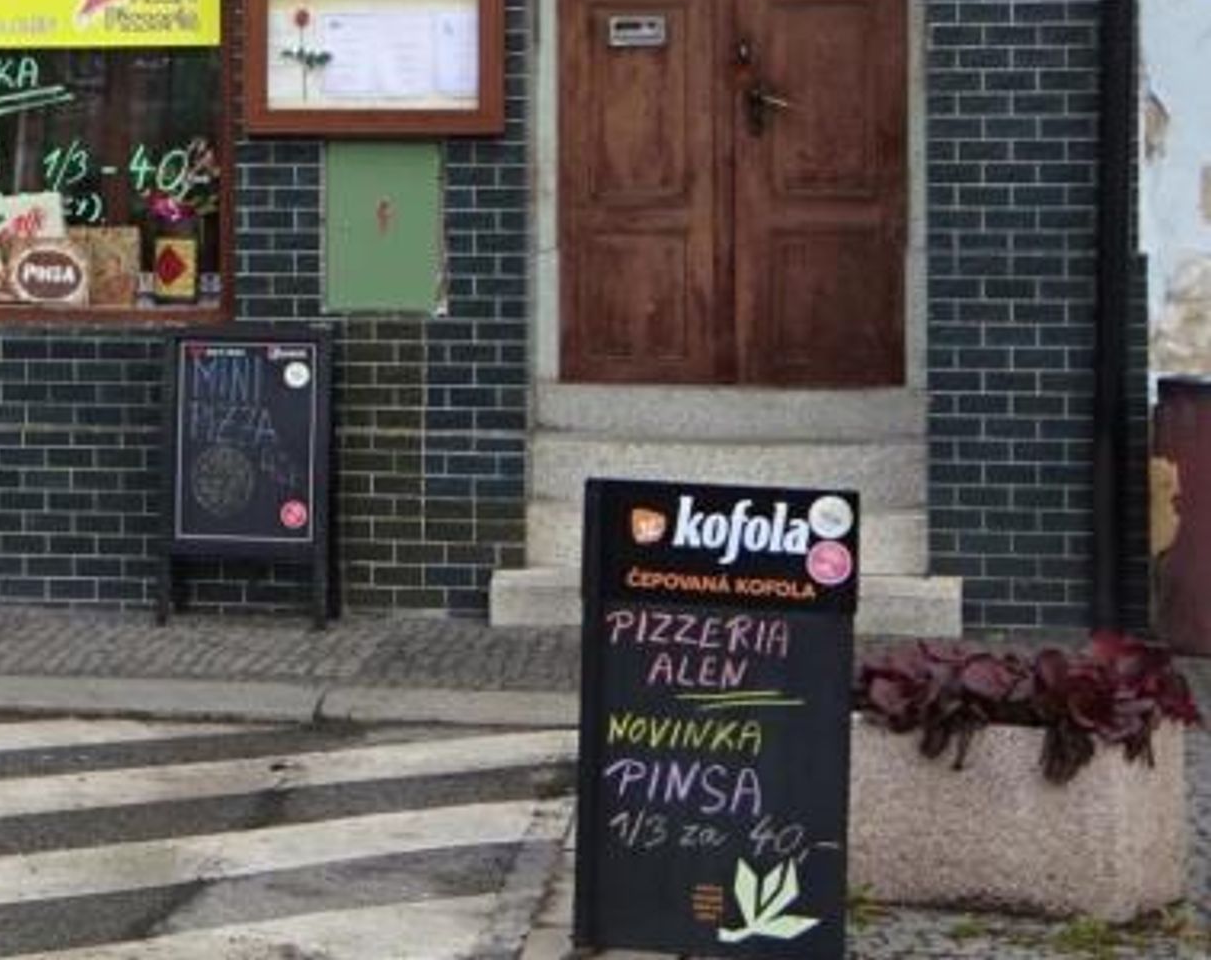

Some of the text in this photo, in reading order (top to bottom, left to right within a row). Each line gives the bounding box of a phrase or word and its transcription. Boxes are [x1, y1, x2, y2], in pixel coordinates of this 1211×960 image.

[43, 141, 89, 191] 1/3
[22, 261, 76, 283] PINSA
[672, 496, 810, 564] kofola
[627, 567, 817, 599] ČEPOVANÁ KOFOLA
[606, 610, 790, 658] PIZZERIA
[647, 651, 748, 688] ALEN
[606, 713, 763, 756] NOVINKA
[603, 757, 763, 816] PINSA
[609, 808, 667, 847] 1/3
